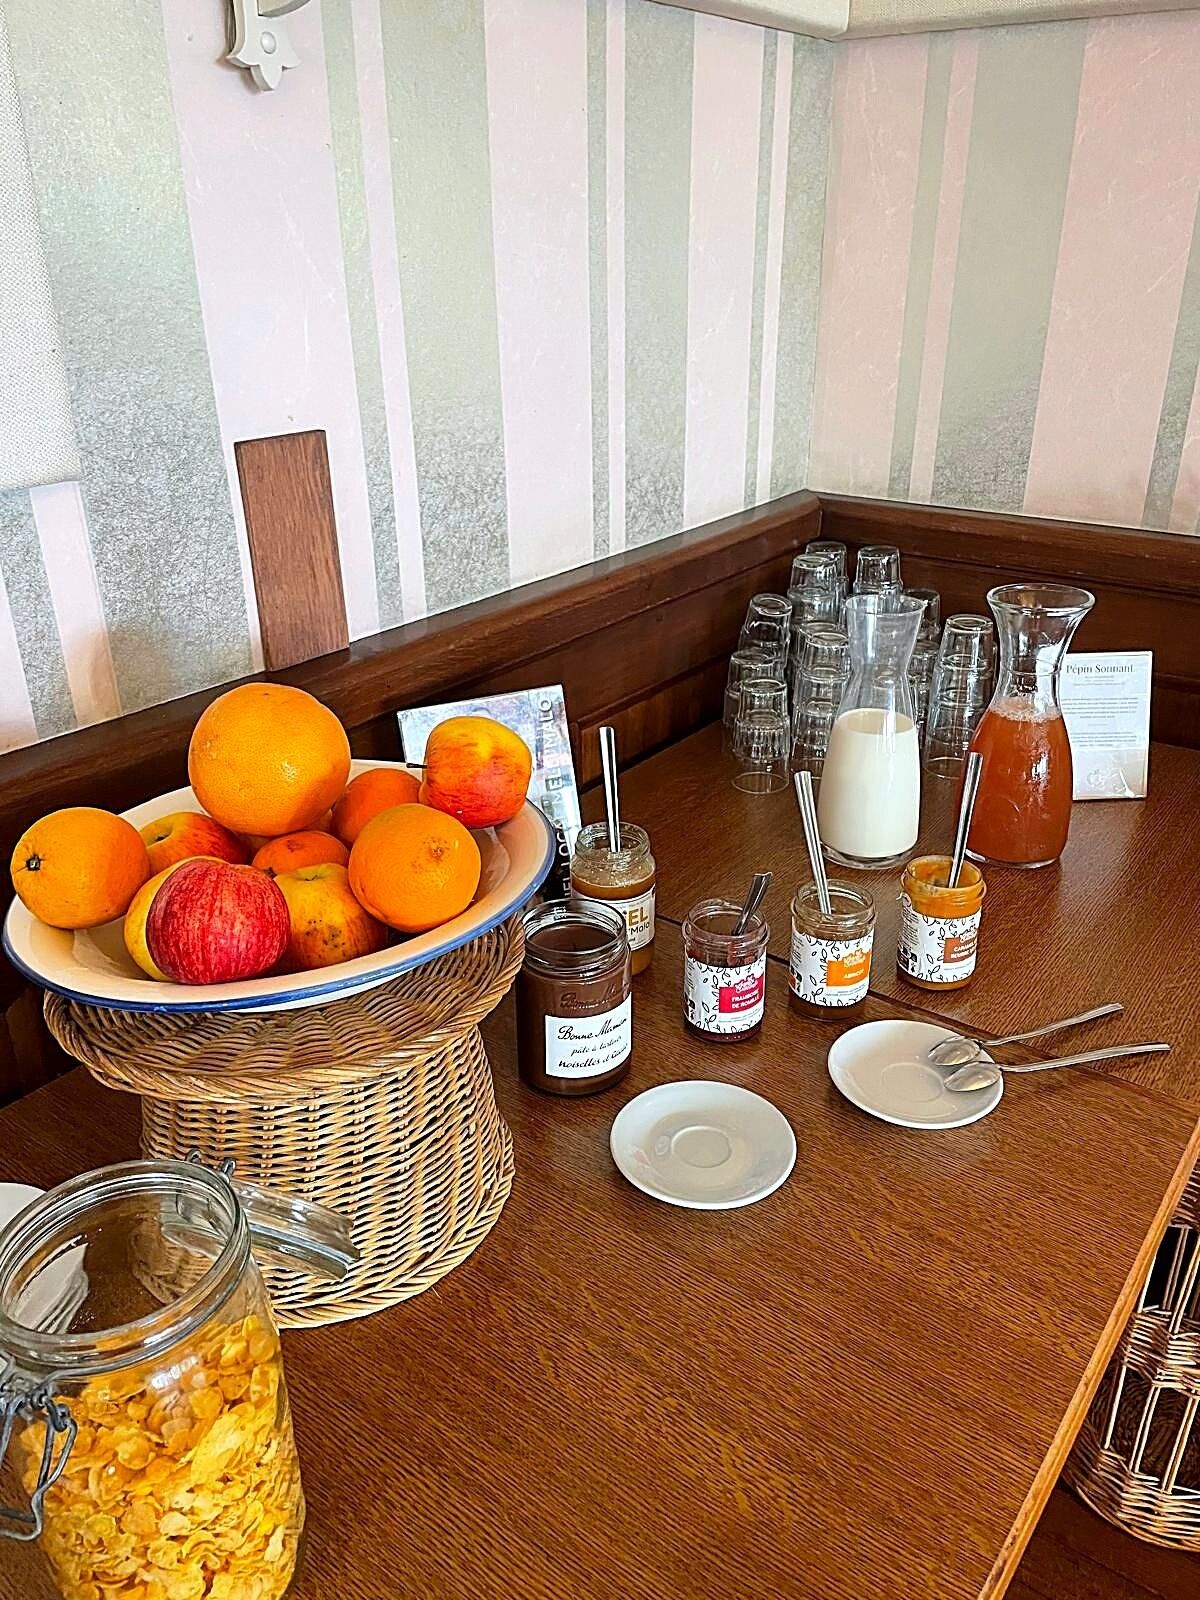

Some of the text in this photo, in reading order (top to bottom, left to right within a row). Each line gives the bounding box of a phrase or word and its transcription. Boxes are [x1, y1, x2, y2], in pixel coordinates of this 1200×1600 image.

[1066, 663, 1134, 675] Pépin Sonnant
[628, 906, 649, 927] EL
[628, 921, 650, 935] 'Malo
[731, 988, 760, 1002] FRAMBOISE
[557, 1018, 627, 1041] Bonne Maman
[571, 1046, 590, 1057] pâte
[602, 1054, 610, 1063] et
